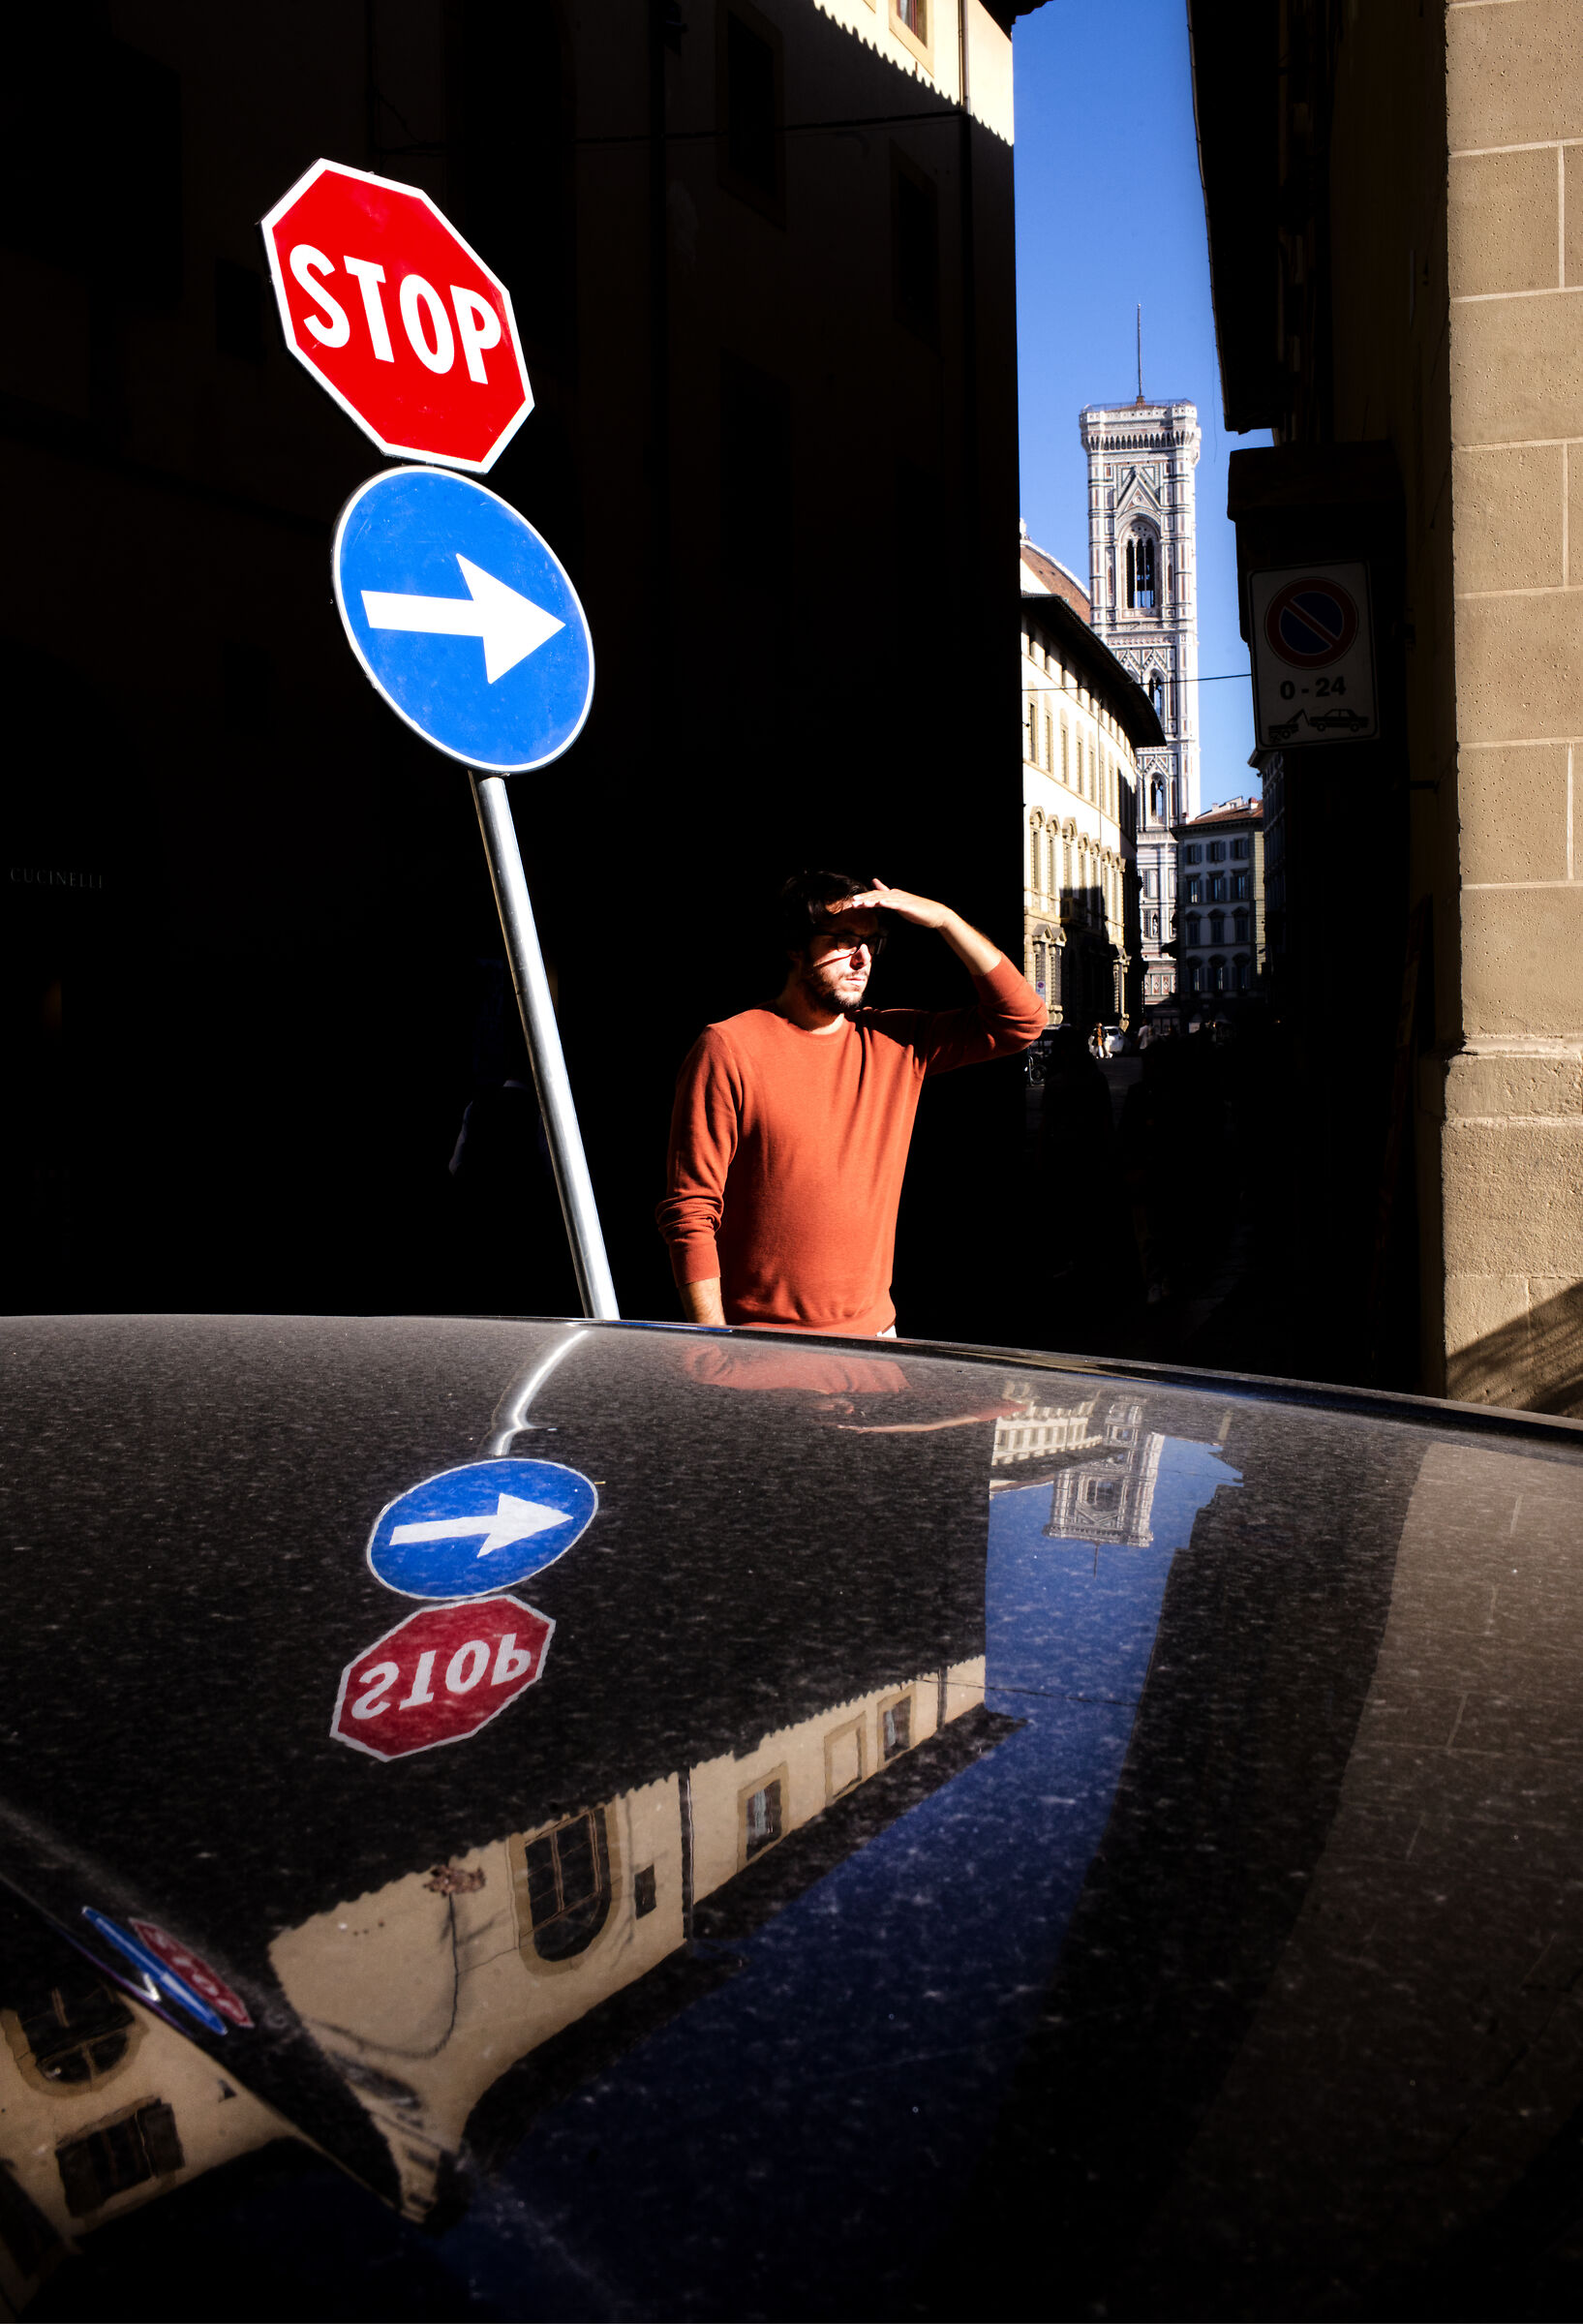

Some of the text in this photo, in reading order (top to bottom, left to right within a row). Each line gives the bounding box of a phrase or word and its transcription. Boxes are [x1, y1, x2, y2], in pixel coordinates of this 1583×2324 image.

[289, 244, 502, 384] STOP
[1281, 681, 1295, 699] 0
[1316, 677, 1346, 696] 24
[10, 868, 105, 889] CUCINELLI
